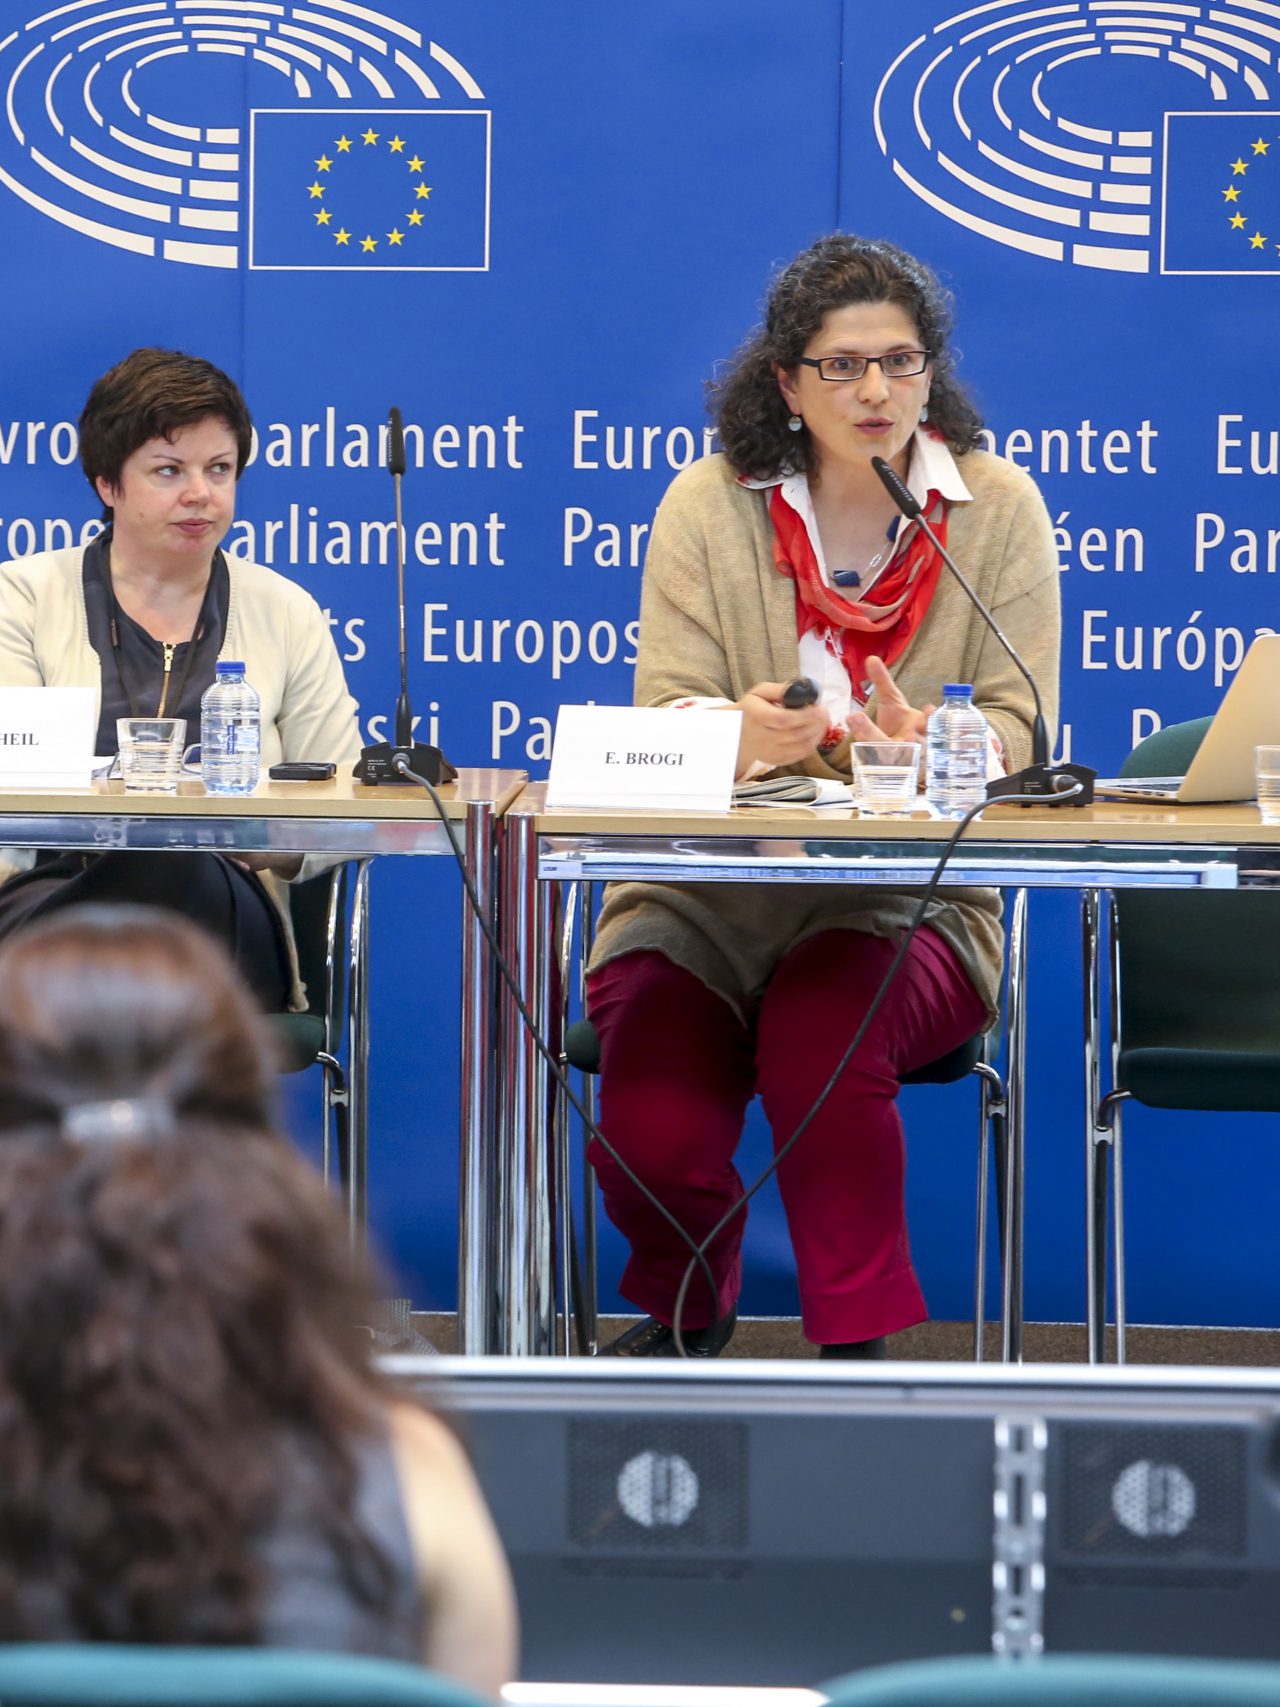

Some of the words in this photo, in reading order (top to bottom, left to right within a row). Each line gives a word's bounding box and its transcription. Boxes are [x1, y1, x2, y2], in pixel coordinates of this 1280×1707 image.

[977, 419, 1158, 474] entet
[564, 507, 659, 567] Par
[1082, 610, 1277, 687] Európ
[605, 751, 620, 765] E.
[625, 752, 685, 766] BROGI
